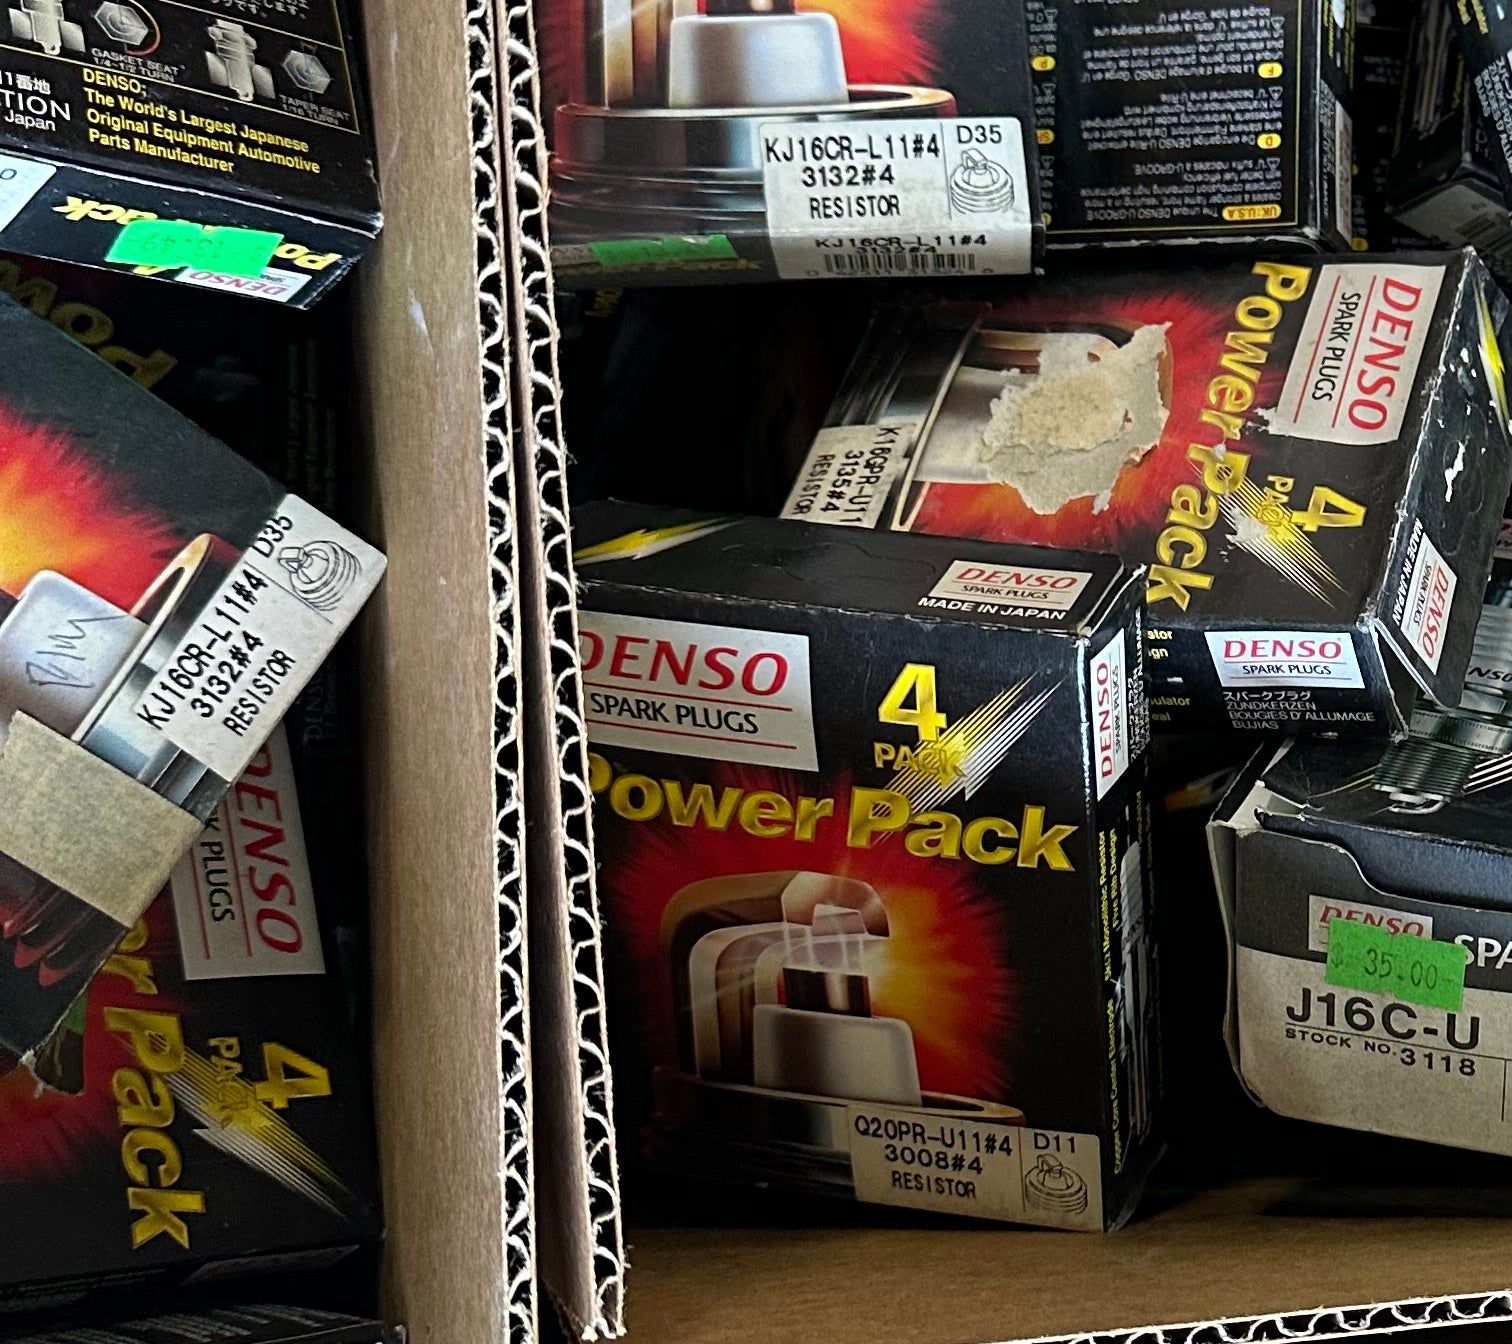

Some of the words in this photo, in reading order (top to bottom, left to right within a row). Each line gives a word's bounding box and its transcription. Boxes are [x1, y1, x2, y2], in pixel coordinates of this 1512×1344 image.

[3, 109, 56, 132] Japan
[84, 88, 114, 107] The
[118, 95, 177, 122] World's
[180, 108, 238, 136] Largest
[238, 123, 309, 153] Japanese
[86, 109, 150, 136] Original
[153, 122, 235, 156] Equipment
[238, 142, 321, 174] Automotive
[956, 124, 1001, 144] D35
[89, 128, 132, 153] Parts
[134, 138, 235, 173] Manufacturer
[765, 134, 940, 163] KJ16CR-L11#4
[802, 166, 895, 187] 3132#4
[809, 195, 901, 218] RESISTOR
[189, 270, 290, 298] DENSO
[1326, 291, 1362, 348] SPARK
[1200, 261, 1313, 442] Power
[1311, 348, 1346, 402] PLUGS
[1349, 276, 1423, 431] DENSO
[793, 454, 836, 515] RESISTOR
[820, 450, 865, 512] 3135#4
[251, 514, 294, 558] D35
[1146, 442, 1250, 611] Pack
[1406, 518, 1422, 558] MADE
[955, 567, 1078, 590] DENSO
[1402, 559, 1412, 576] IN
[917, 596, 974, 612] MADE
[977, 603, 997, 614] IN
[999, 604, 1066, 621] JAPAN
[961, 584, 1003, 597] SPARK
[1005, 588, 1049, 600] PLUGS
[1393, 575, 1409, 627] JAPAN
[1422, 565, 1449, 658] DENSO
[138, 570, 270, 731] KJ16CR-L11#4
[1223, 640, 1342, 659] DENSO
[1242, 665, 1287, 675] SPARK
[1289, 665, 1332, 675] PLUGS
[191, 630, 265, 719] 3132#4
[223, 650, 296, 738] RESISTOR
[1223, 691, 1311, 701] スパークプラグ
[590, 691, 686, 729] SPARK
[691, 701, 759, 736] PLUGS
[877, 662, 948, 742] 4
[1097, 660, 1112, 779] DENSO
[1229, 711, 1288, 720] BOUGIES
[1305, 712, 1375, 721] ALLUMAGE
[1232, 721, 1279, 729] BUJIAS
[846, 784, 1081, 873] Pack
[201, 840, 236, 923] PLUGS
[1286, 986, 1481, 1052] J16C-U
[255, 1042, 333, 1109] 4
[1285, 1027, 1352, 1050] STOCK
[1364, 1041, 1397, 1057] NO.
[1400, 1049, 1477, 1078] 3118
[103, 1006, 206, 1250] Pack
[1032, 1129, 1078, 1154] D11
[882, 1143, 984, 1176] 3008#4
[891, 1169, 978, 1200] RESISTOR
